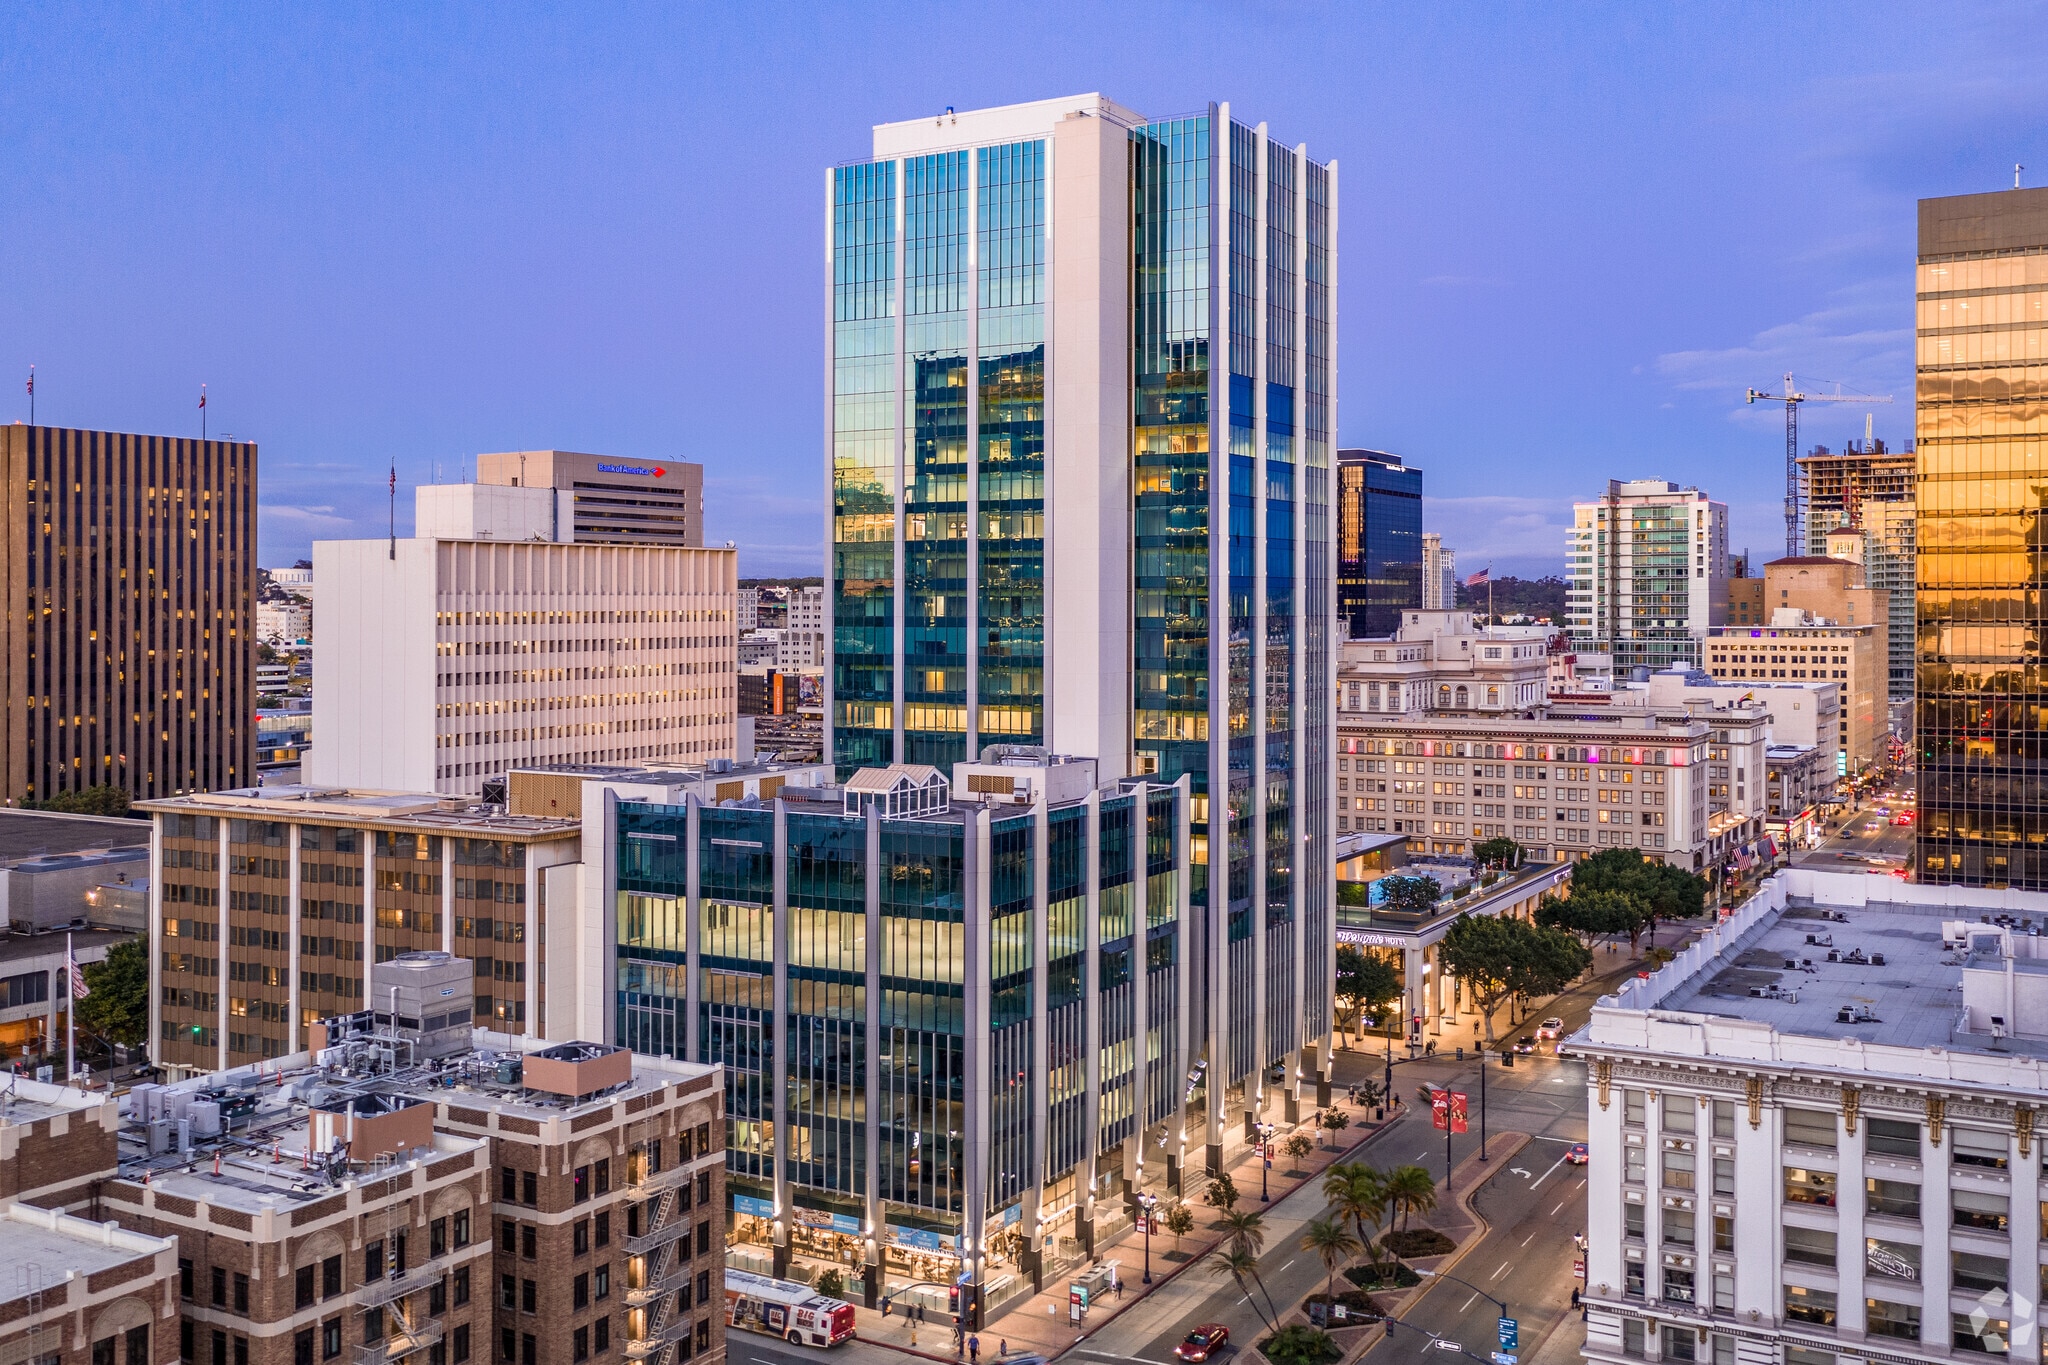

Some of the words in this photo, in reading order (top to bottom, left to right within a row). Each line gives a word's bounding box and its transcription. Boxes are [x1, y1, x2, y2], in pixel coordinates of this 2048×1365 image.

[598, 463, 615, 472] Bank
[622, 465, 649, 475] America
[1384, 936, 1407, 946] HOTEL
[797, 1308, 815, 1320] BIG
